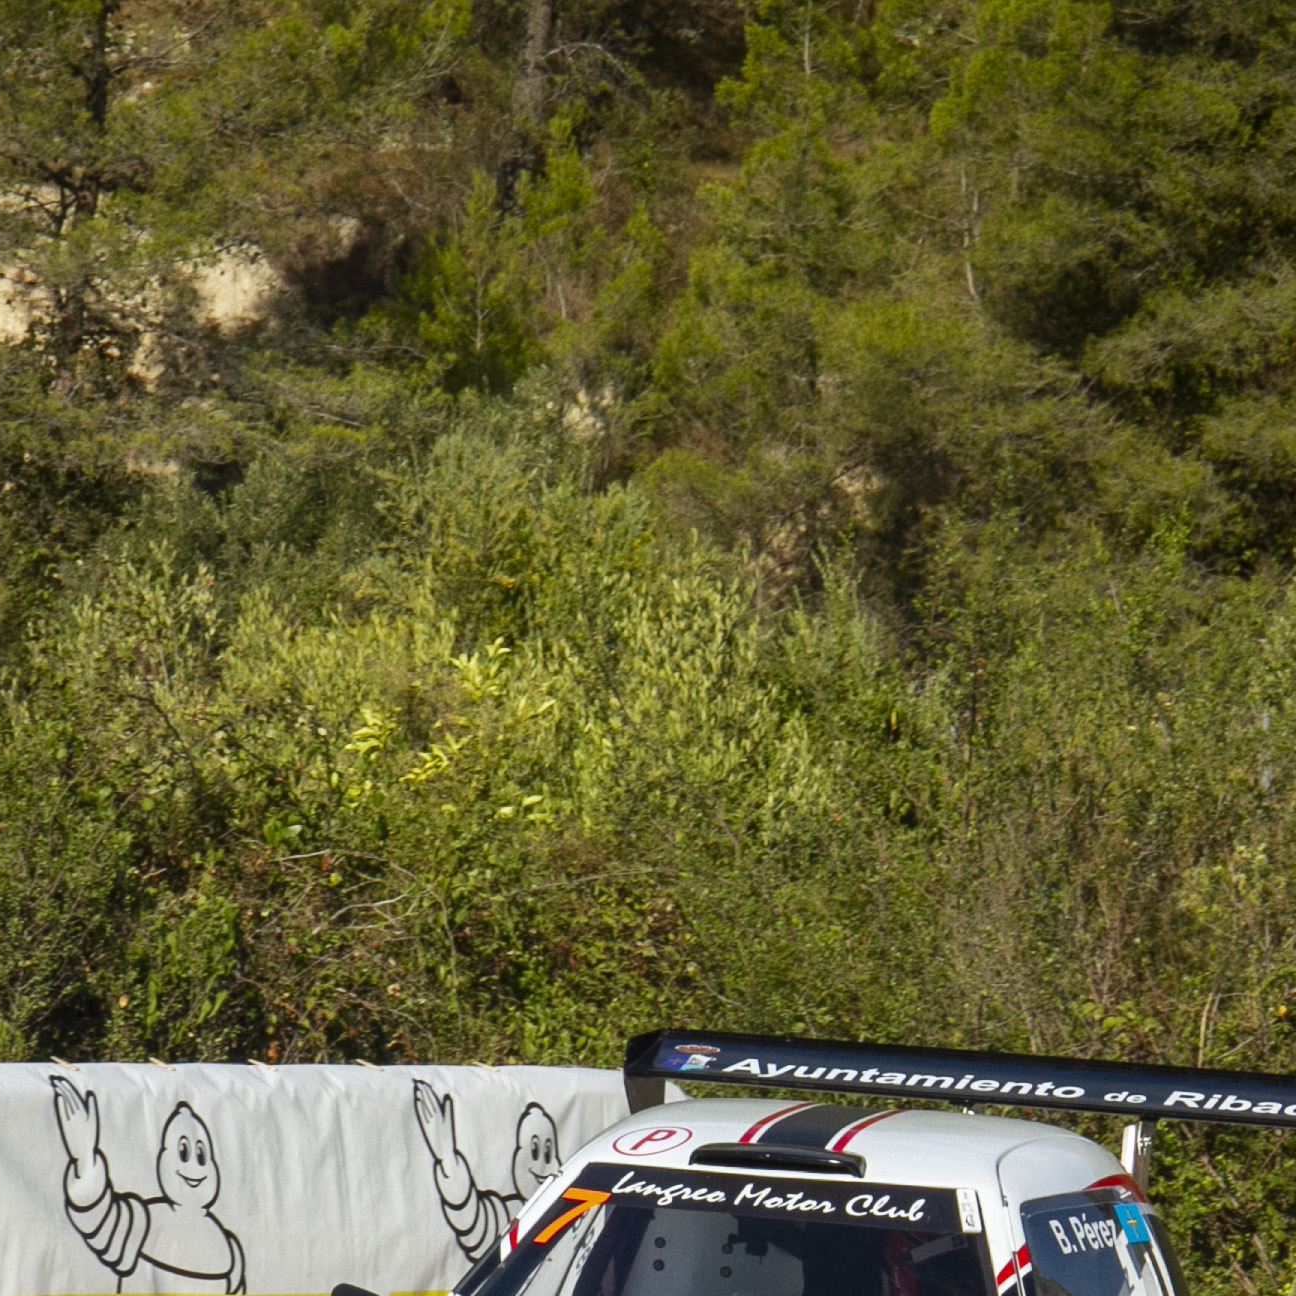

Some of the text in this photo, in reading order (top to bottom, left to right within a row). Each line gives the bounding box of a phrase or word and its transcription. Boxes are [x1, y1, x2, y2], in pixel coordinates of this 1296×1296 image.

[722, 1058, 1086, 1099] Ayuntamiento
[1103, 1090, 1147, 1104] de
[630, 1129, 677, 1151] P
[534, 1187, 612, 1244] 7
[612, 1171, 923, 1222] Langreo Motor Club
